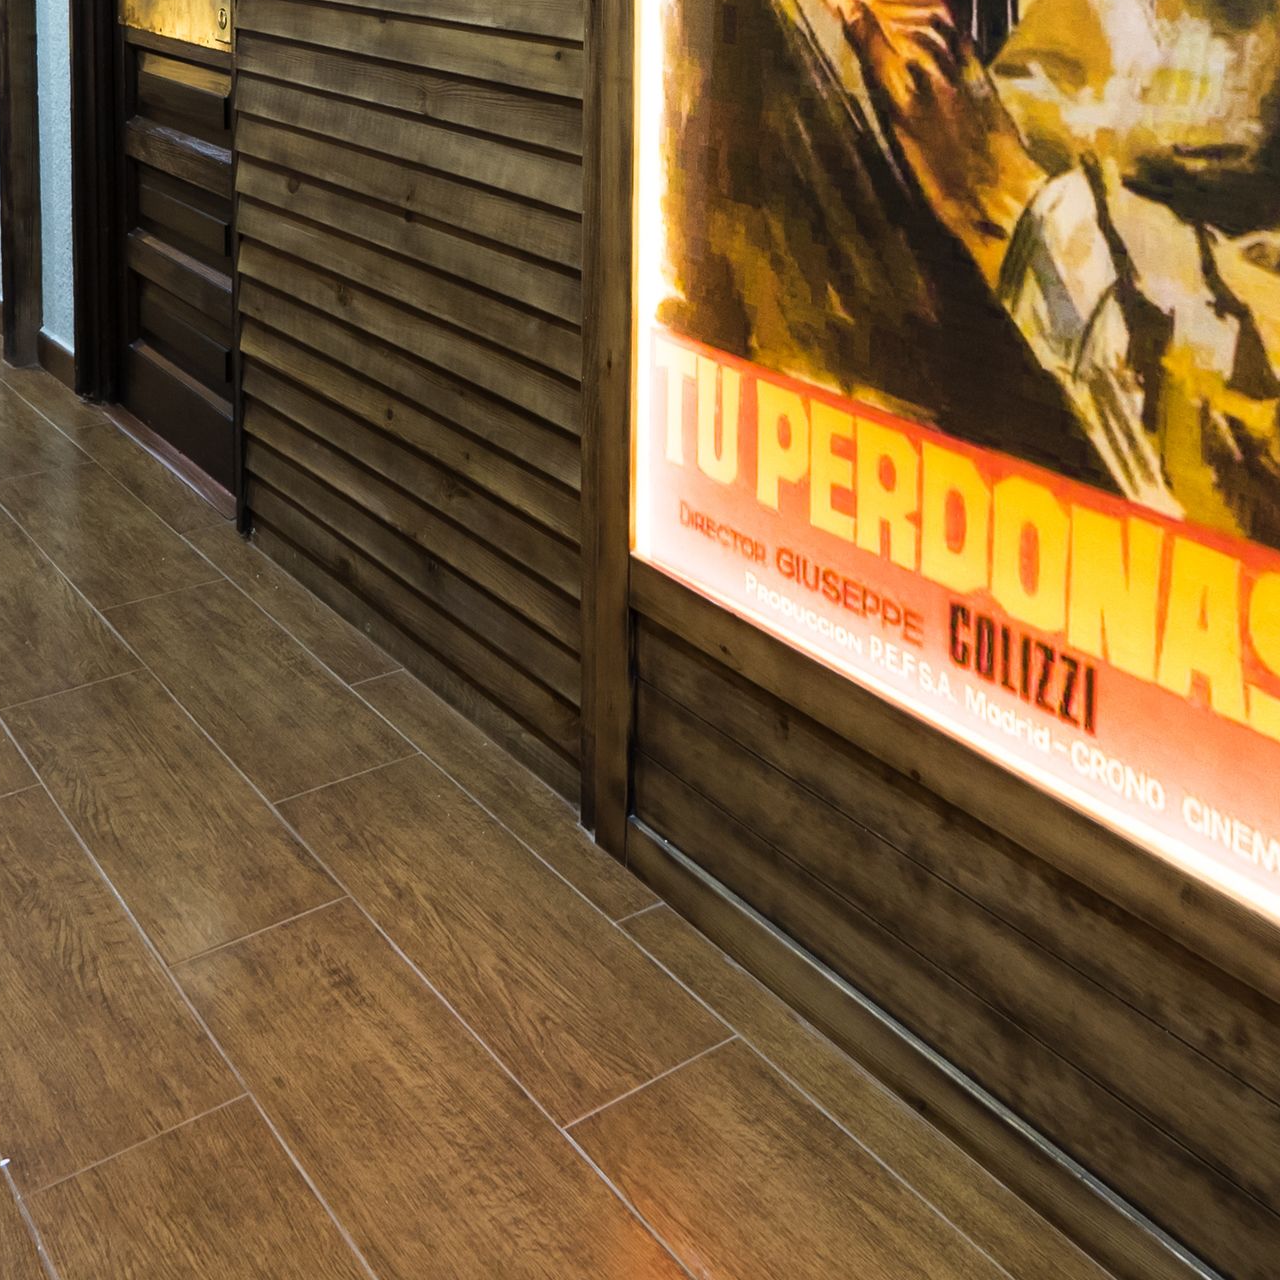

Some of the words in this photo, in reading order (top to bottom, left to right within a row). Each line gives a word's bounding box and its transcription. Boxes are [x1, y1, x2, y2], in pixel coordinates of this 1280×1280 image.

[655, 338, 741, 487] TU
[680, 499, 767, 564] DIRECTOR
[776, 546, 925, 648] GIUSEPPE
[949, 601, 1098, 737] COLIZZI
